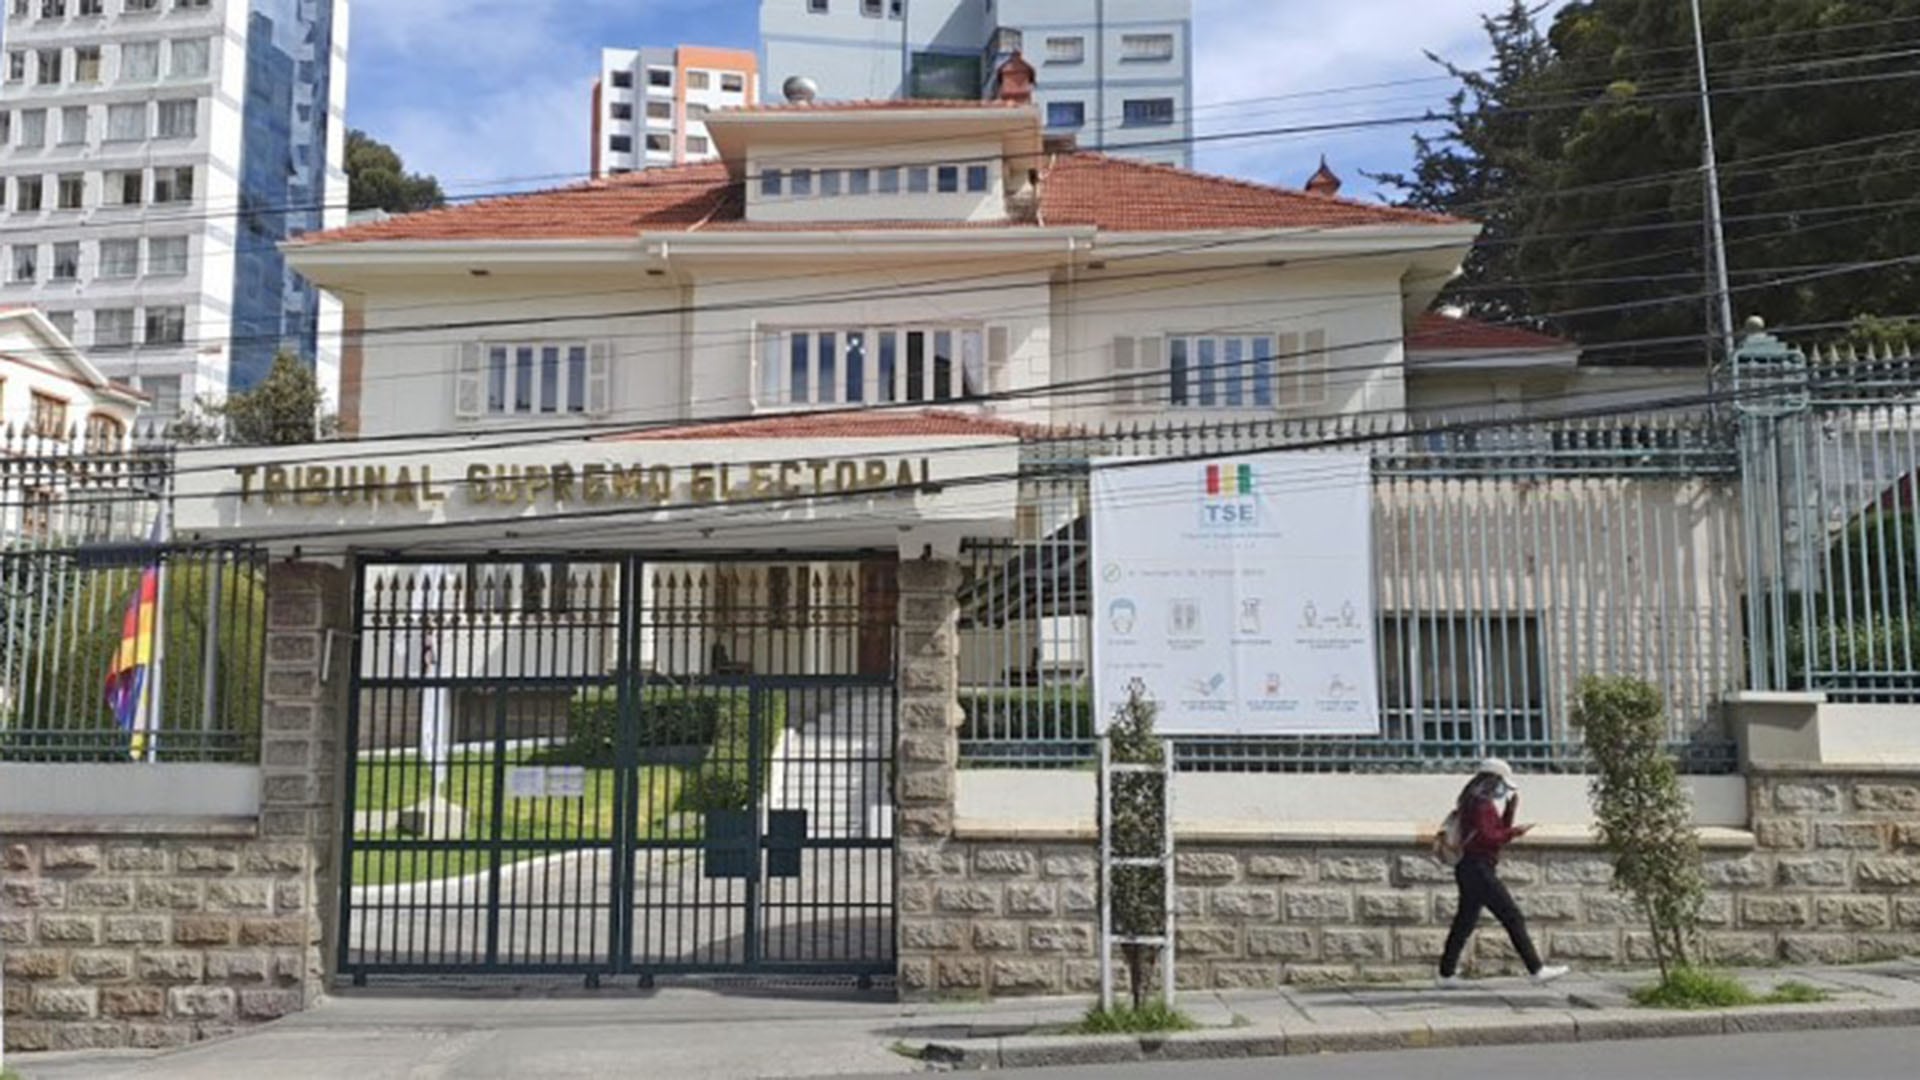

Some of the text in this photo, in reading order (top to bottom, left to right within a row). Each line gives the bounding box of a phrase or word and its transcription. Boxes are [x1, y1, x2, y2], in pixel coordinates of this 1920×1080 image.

[235, 456, 942, 504] TRIBUNAL SUPREMO ELECTORAL
[1205, 504, 1254, 521] TSE
